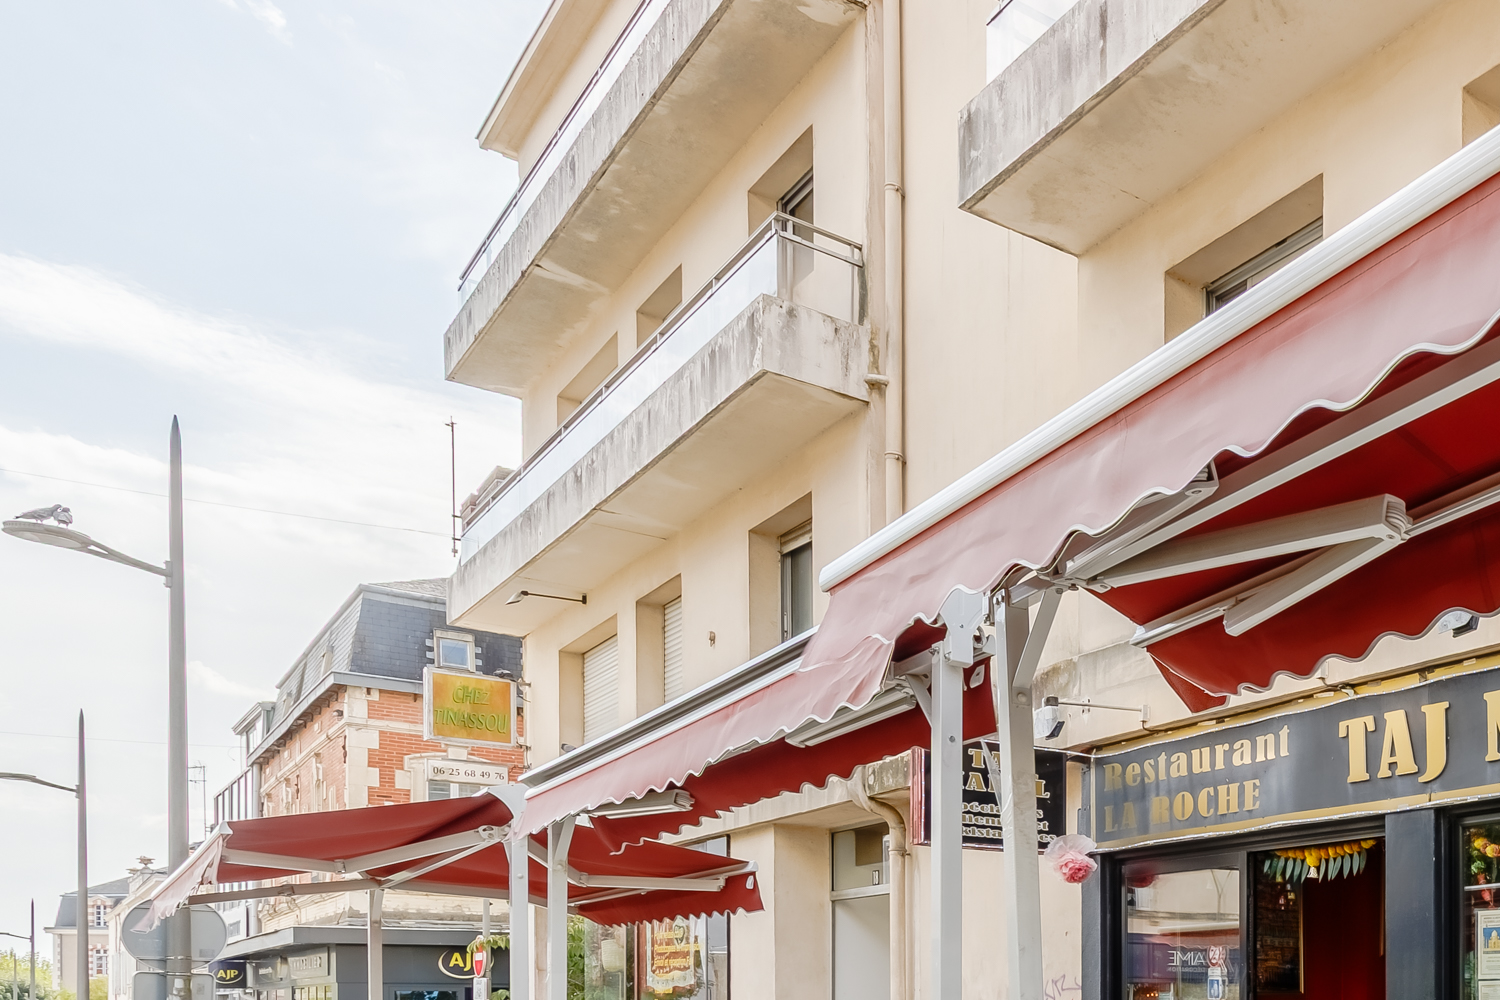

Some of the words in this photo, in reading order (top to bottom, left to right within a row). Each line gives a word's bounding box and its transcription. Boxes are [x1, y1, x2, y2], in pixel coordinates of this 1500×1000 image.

[452, 685, 490, 706] CHEZ
[434, 708, 508, 734] TINASSOU
[1338, 700, 1450, 784] TAJ
[1103, 724, 1290, 792] Restaurant
[432, 766, 445, 776] 06
[448, 767, 460, 777] 25
[464, 769, 476, 778] 68
[480, 770, 491, 779] 49
[494, 772, 505, 781] 76
[1104, 801, 1137, 833] LA
[1151, 778, 1261, 825] ROCHE
[449, 952, 475, 972] AJ
[217, 969, 239, 980] AJP
